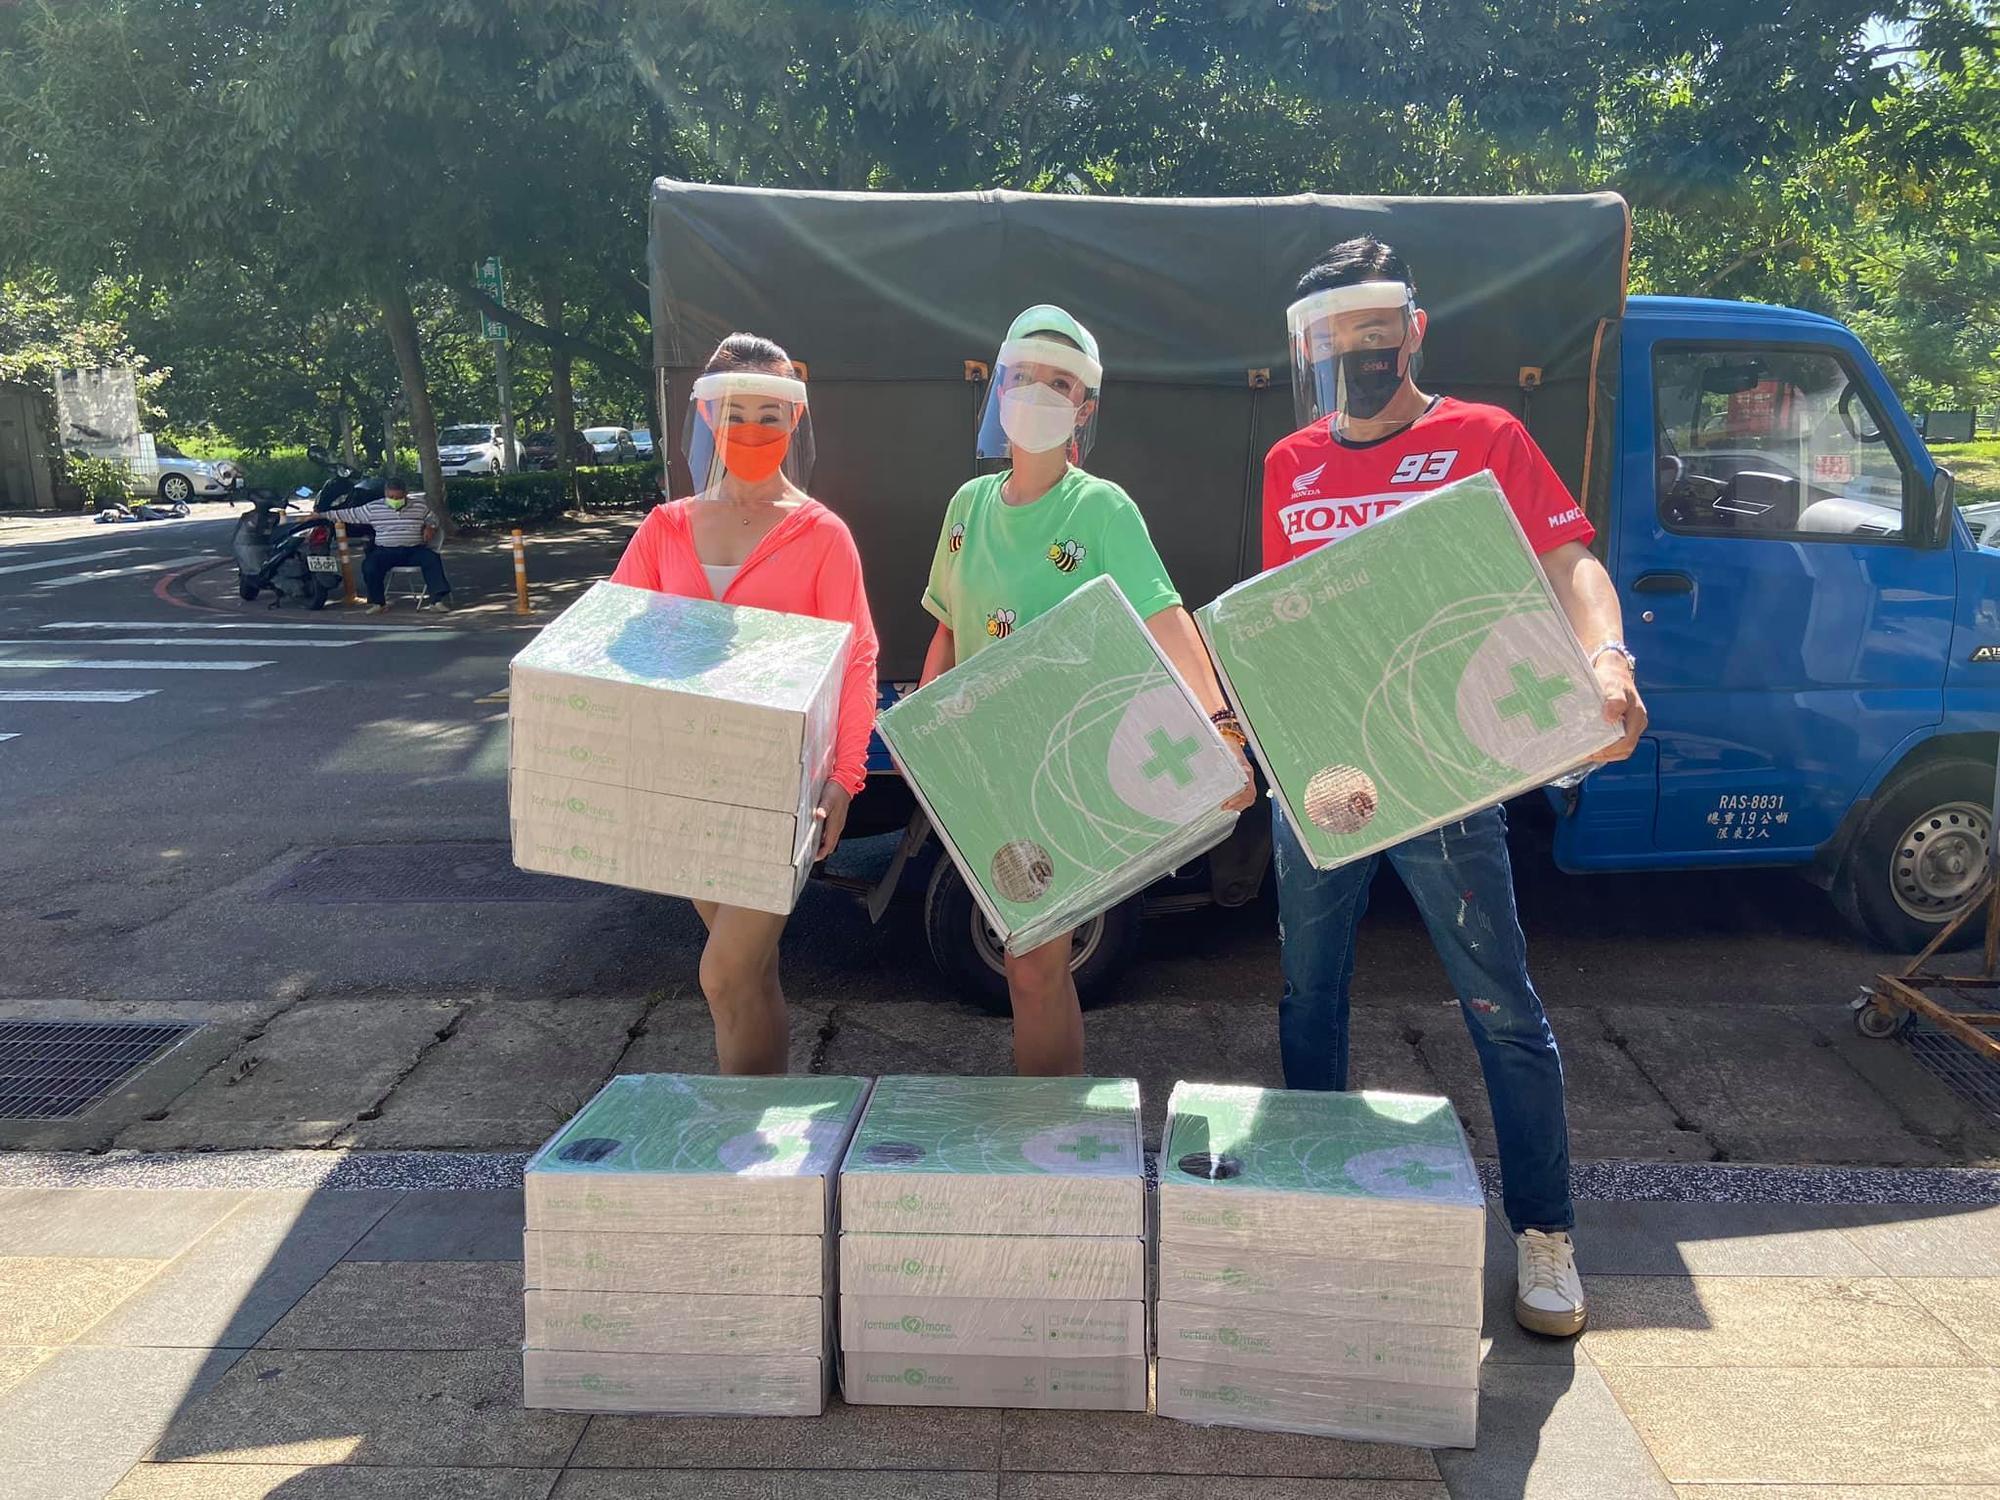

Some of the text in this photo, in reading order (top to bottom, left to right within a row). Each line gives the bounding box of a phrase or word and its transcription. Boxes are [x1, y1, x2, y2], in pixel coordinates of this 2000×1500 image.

[1389, 450, 1459, 484] 93
[1290, 488, 1320, 499] HONDA
[1237, 567, 1370, 641] face shield
[1719, 795, 1784, 809] RAS-8831
